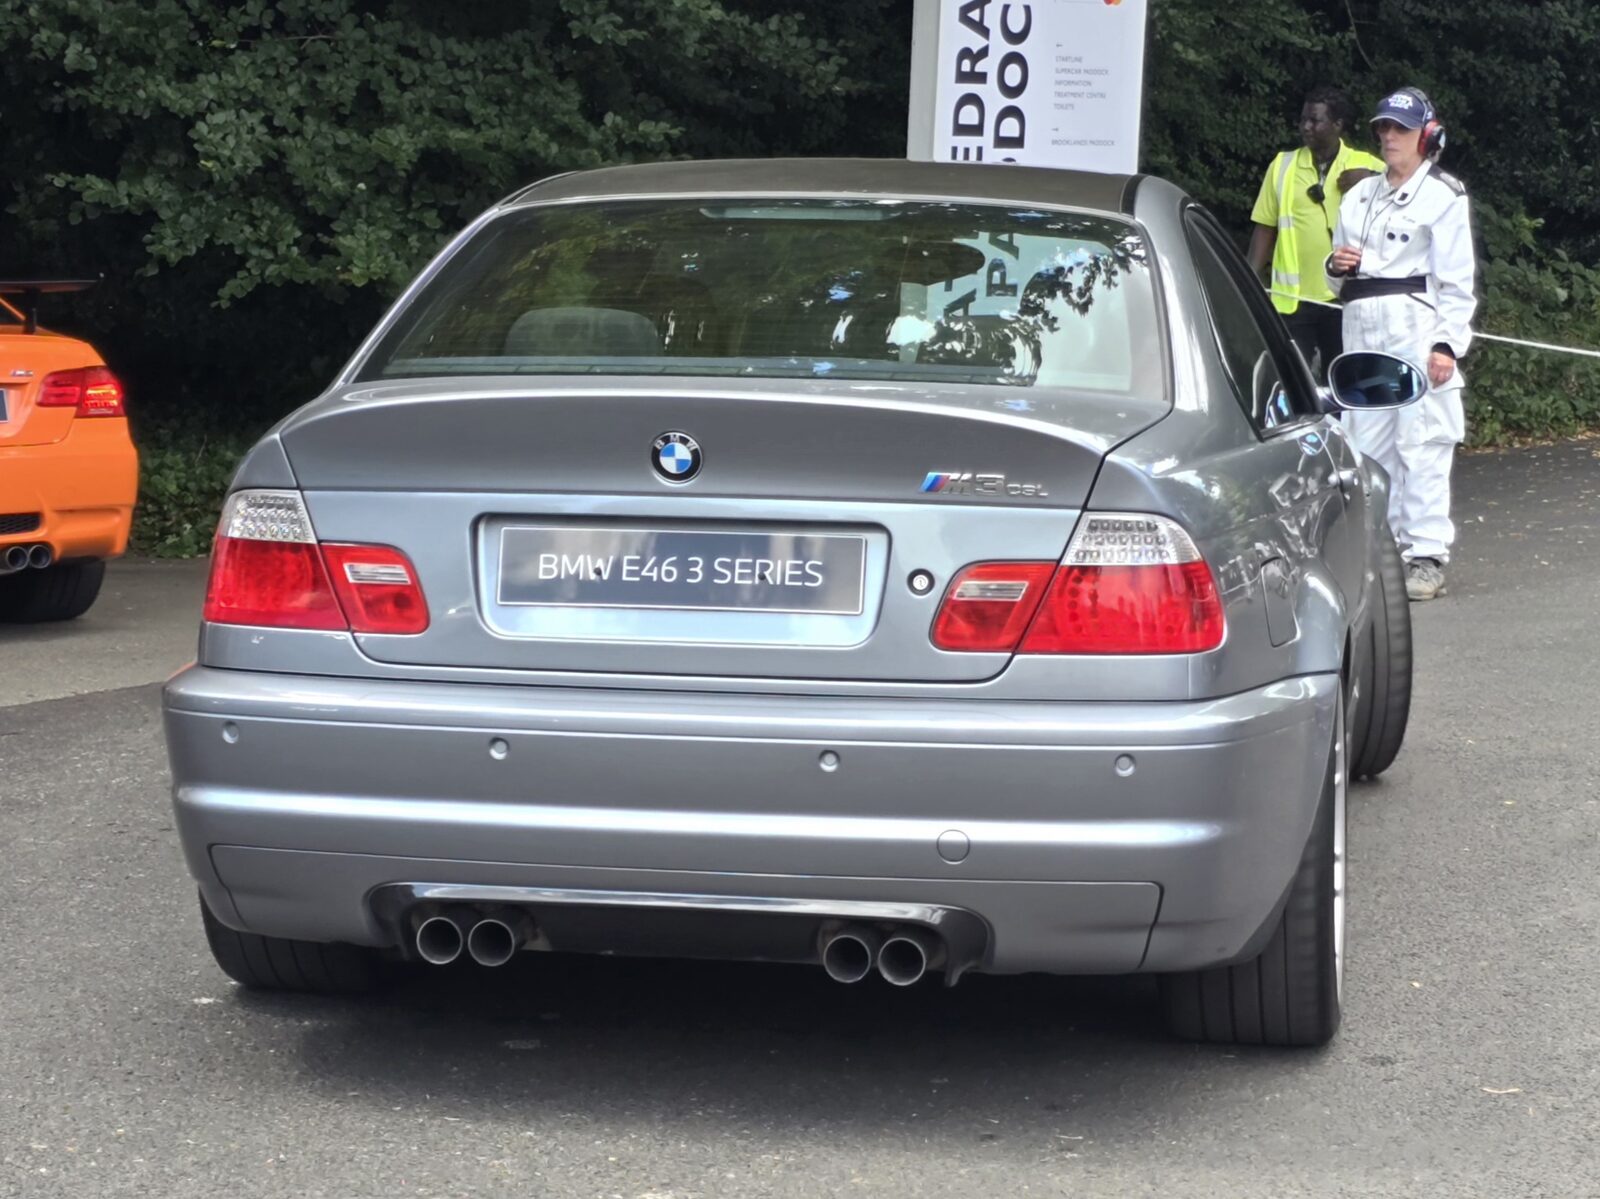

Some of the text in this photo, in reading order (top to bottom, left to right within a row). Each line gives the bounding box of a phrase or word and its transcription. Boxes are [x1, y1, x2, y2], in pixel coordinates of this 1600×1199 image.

[993, 3, 1033, 162] DOC
[538, 553, 823, 587] BMW E46 3 SERIES
